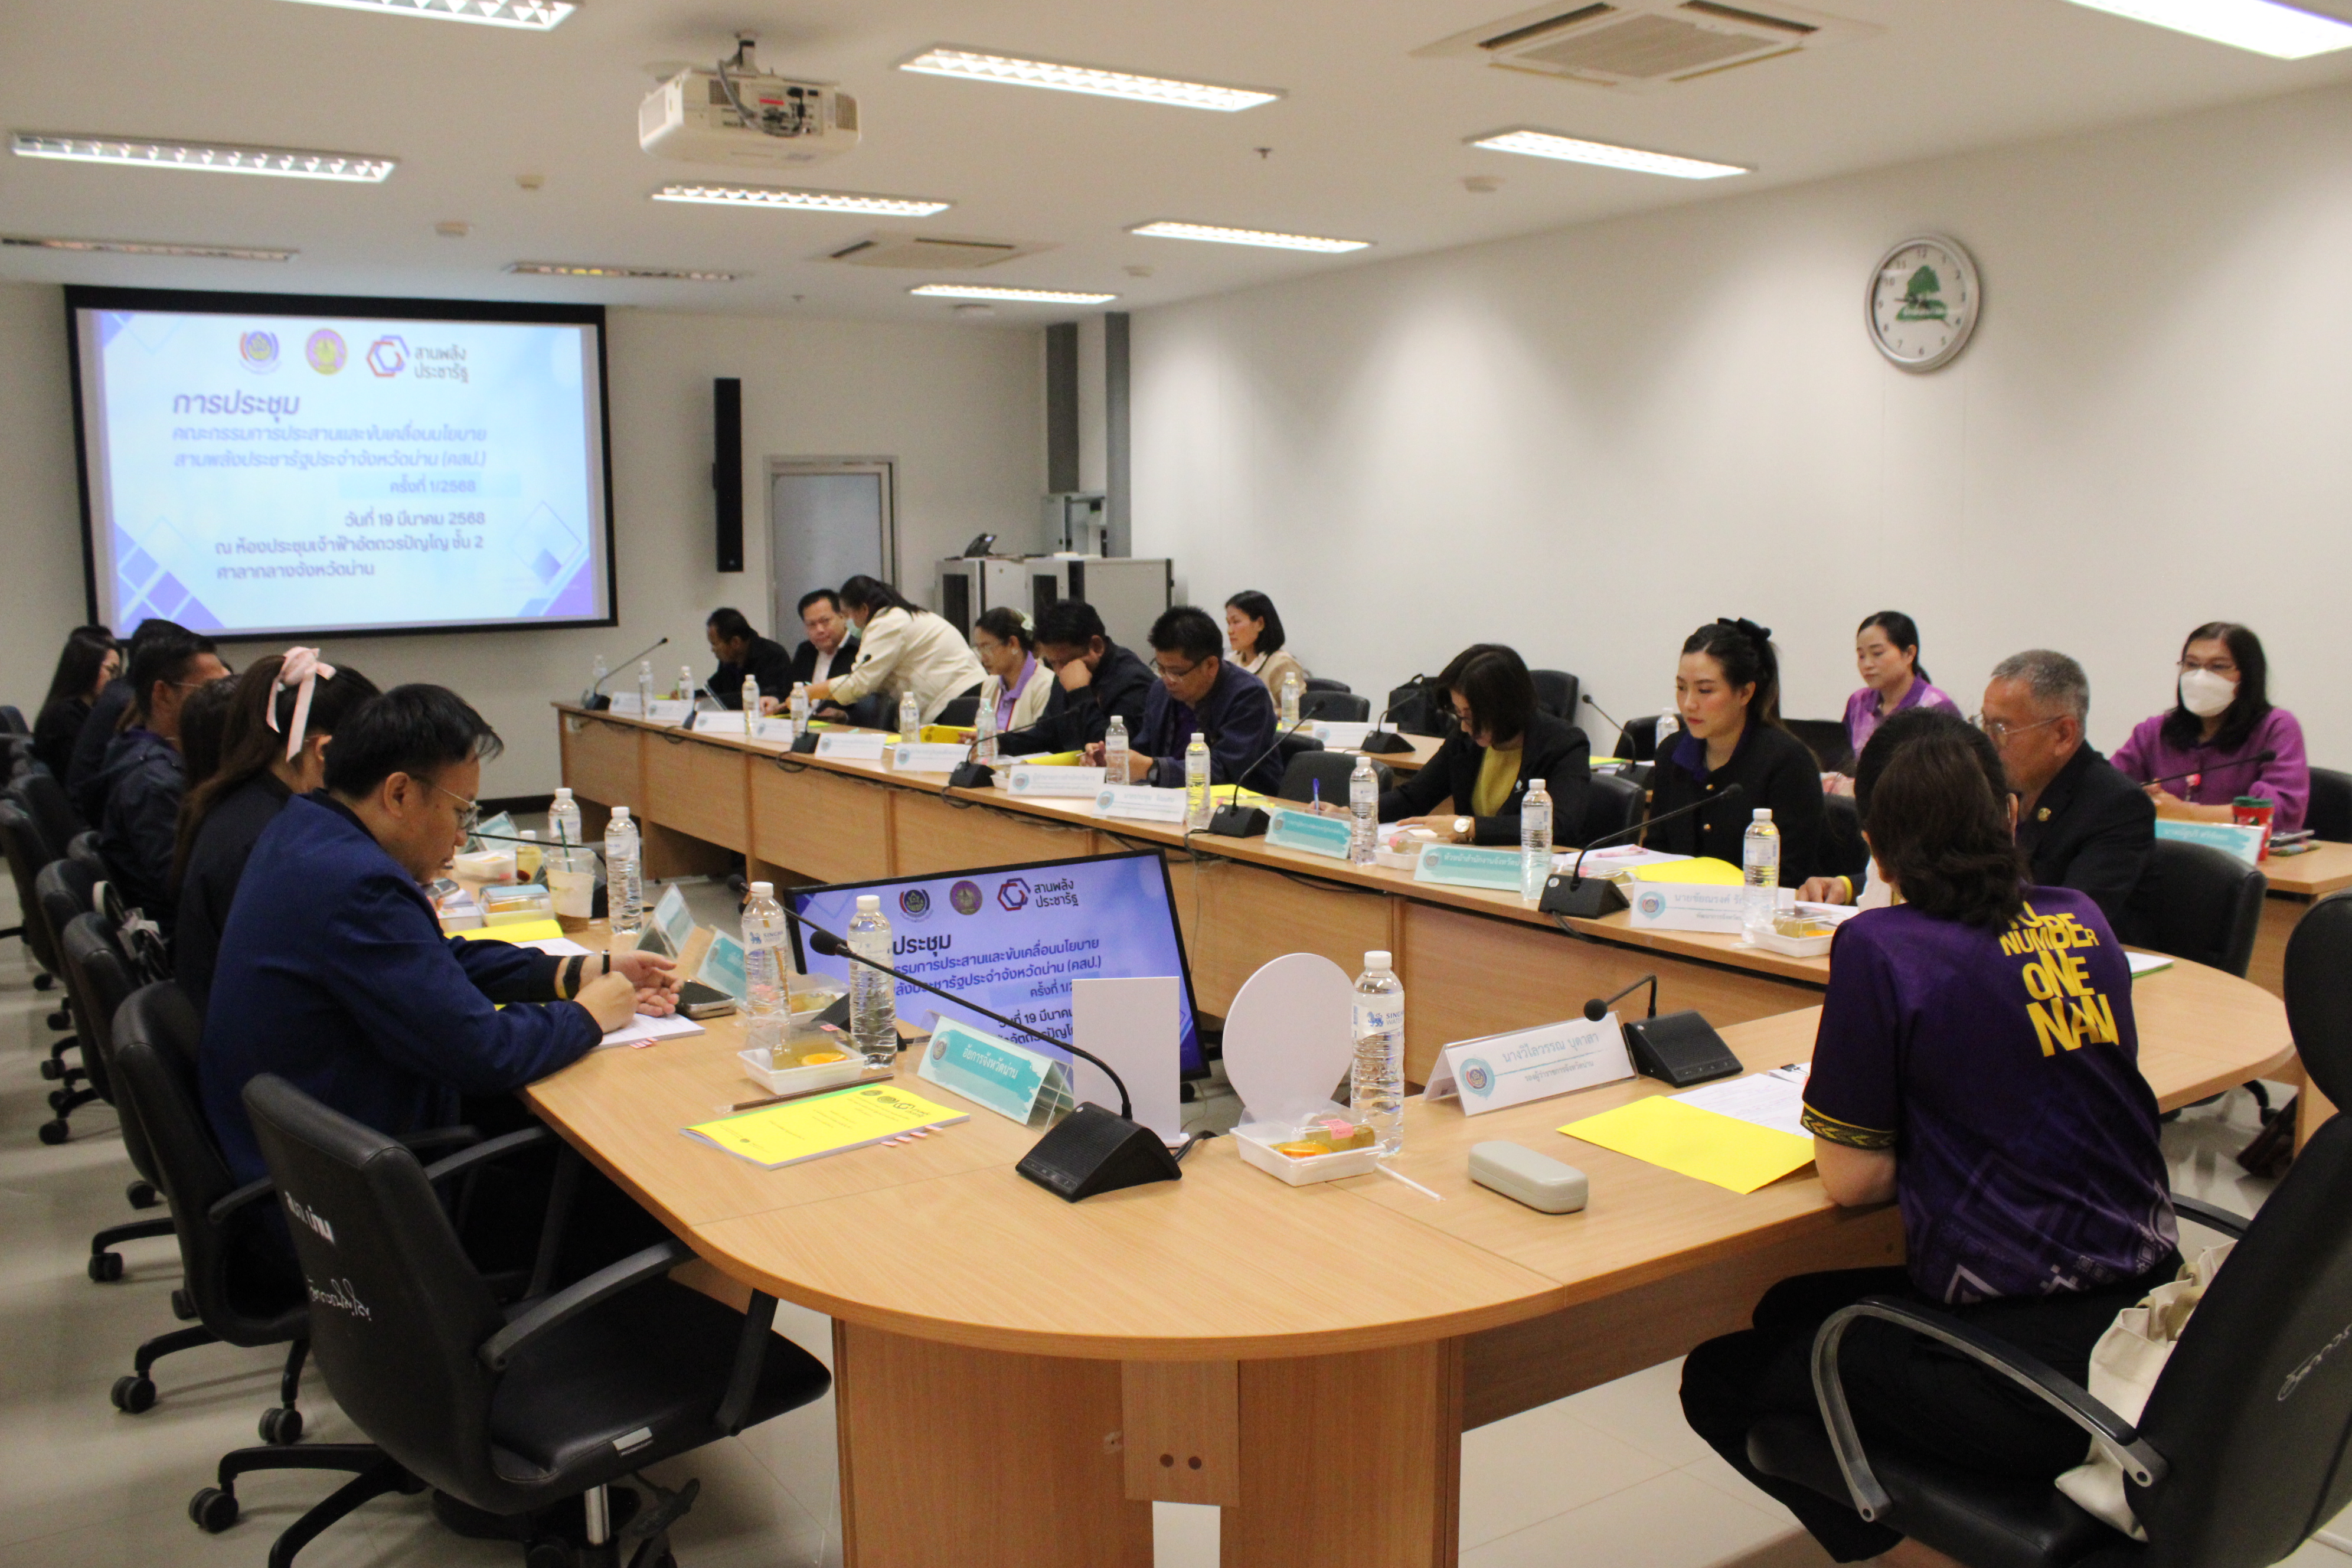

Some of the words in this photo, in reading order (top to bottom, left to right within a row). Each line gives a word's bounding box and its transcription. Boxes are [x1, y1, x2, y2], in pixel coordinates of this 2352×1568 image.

[414, 343, 467, 361] สานพลัง
[414, 362, 469, 383] ประชารัฐ
[173, 389, 300, 423] การประชุม
[390, 473, 426, 494] ครั้งที่
[344, 506, 374, 528] วันที่
[378, 512, 394, 526] 19
[397, 509, 445, 526] มีนาคม
[448, 511, 486, 526] 2568
[215, 541, 232, 555] ณ
[452, 528, 471, 550] ชั้น
[474, 535, 484, 549] 2
[217, 560, 376, 580] ศาลากลางจังหวัดน่าน
[1034, 878, 1074, 894] สานพลัง
[1035, 892, 1079, 908] ประชารัฐ
[1999, 913, 2100, 956] NUMBER
[892, 934, 952, 957] ประชุม
[1067, 955, 1102, 973] (คสป.)
[2022, 949, 2095, 1001] ONE
[1030, 979, 1059, 998] ครั้งที่
[1024, 1013, 1037, 1024] 19
[2026, 994, 2119, 1057] NAN
[962, 1043, 1019, 1080] อัยการจังหวัดน่าน
[1502, 1041, 1566, 1063] นางวิไลวรรณ
